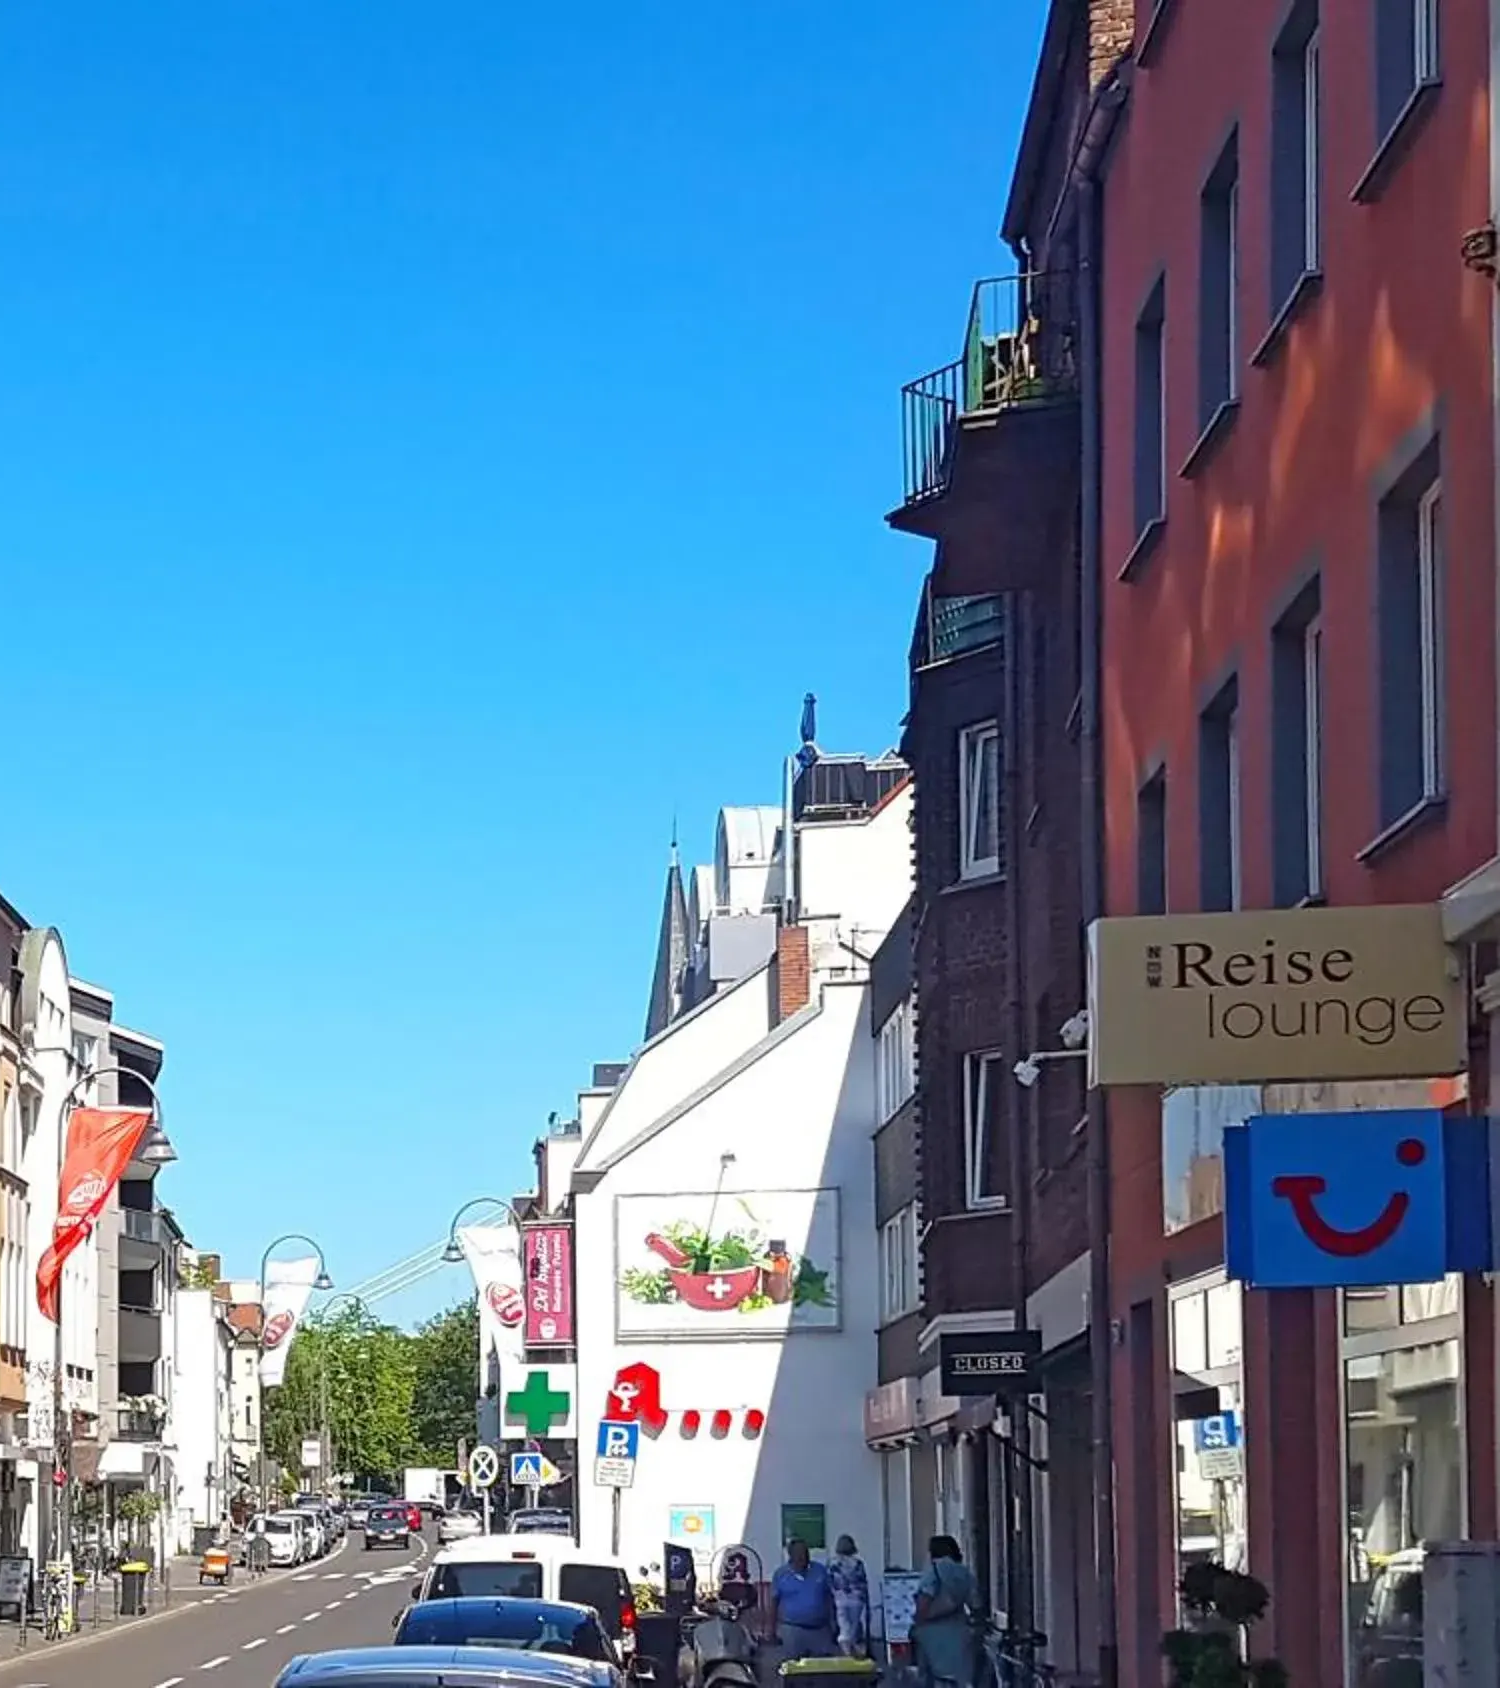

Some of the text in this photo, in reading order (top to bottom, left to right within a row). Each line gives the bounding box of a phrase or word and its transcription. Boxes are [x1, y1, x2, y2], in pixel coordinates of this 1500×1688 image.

[1172, 940, 1354, 989] Reise
[1208, 993, 1445, 1046] lounge
[955, 1356, 1024, 1371] CLOSED
